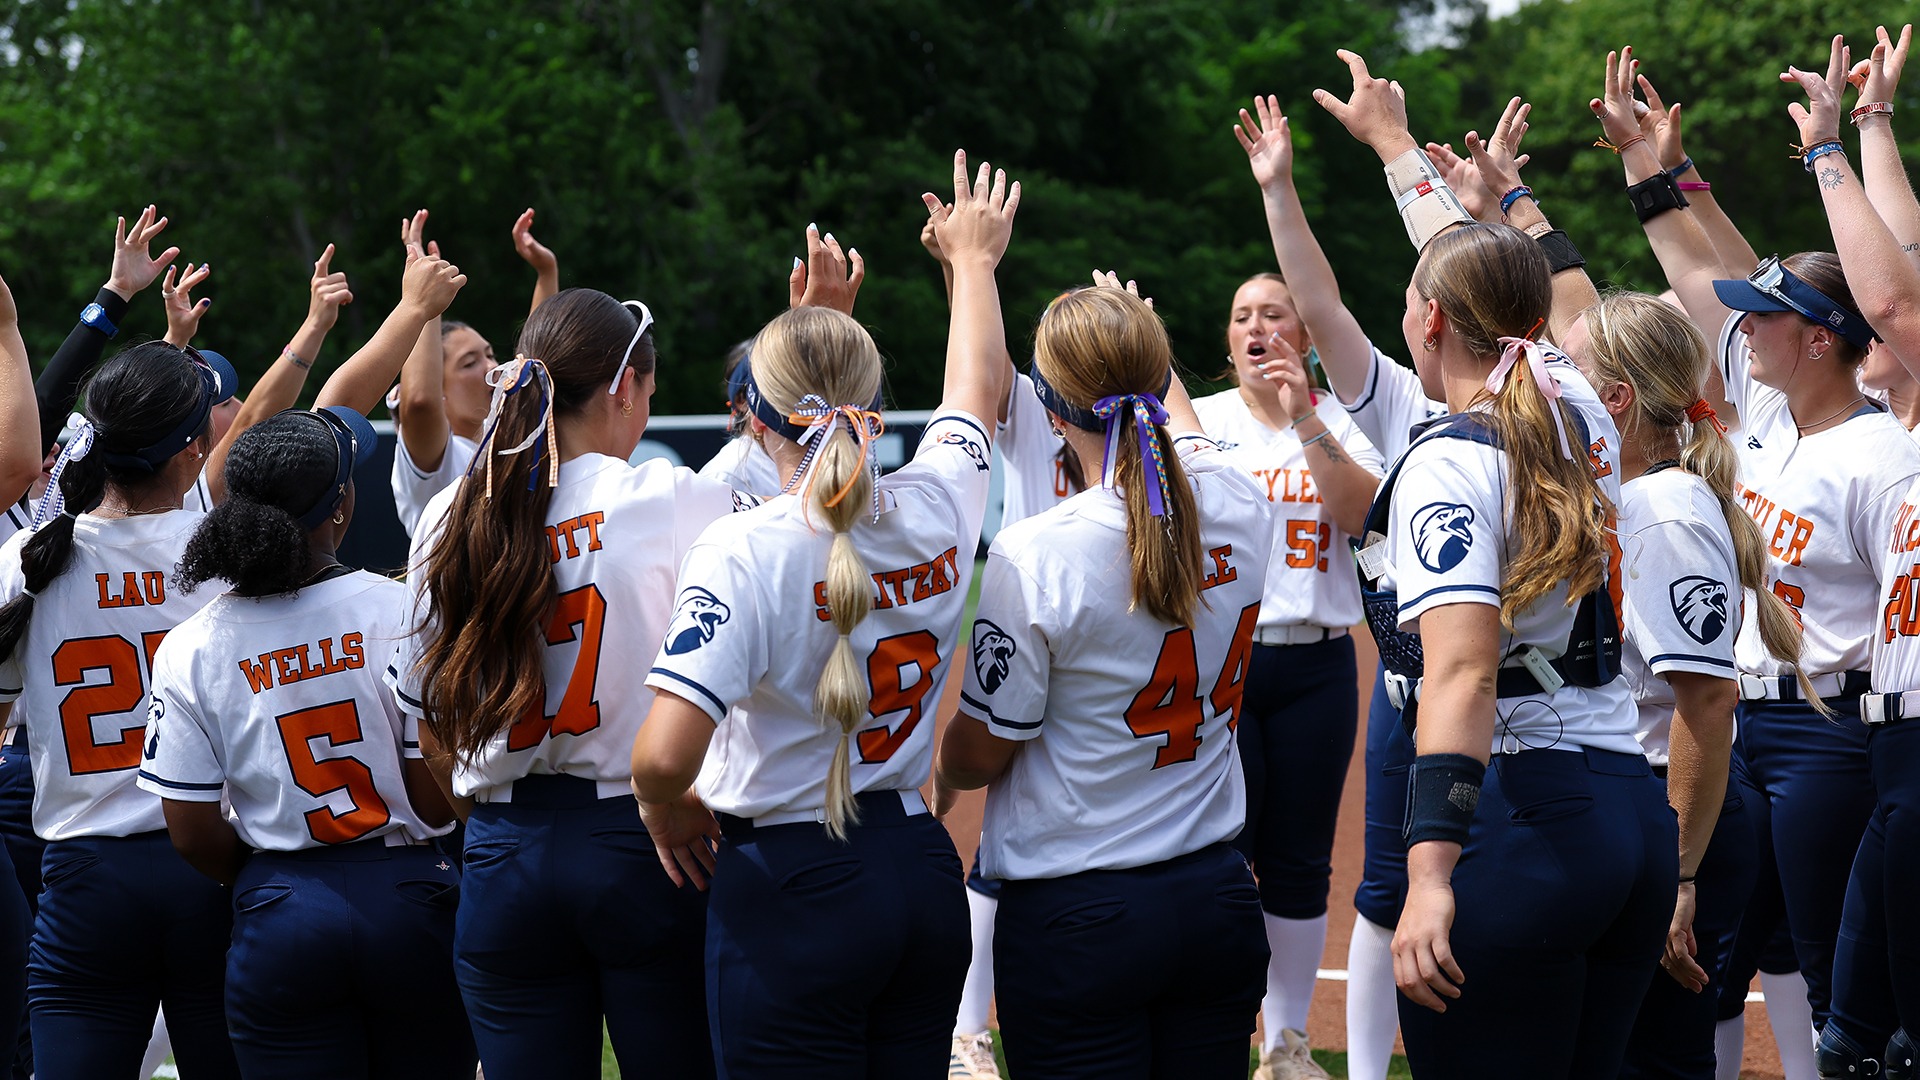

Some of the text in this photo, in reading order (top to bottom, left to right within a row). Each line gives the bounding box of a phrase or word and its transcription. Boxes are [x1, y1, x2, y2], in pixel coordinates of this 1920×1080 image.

[1251, 468, 1324, 504] YLE
[1286, 519, 1331, 573] 52
[95, 571, 165, 609] LAU
[239, 631, 365, 694] WELLS
[1122, 599, 1262, 771] 44
[856, 629, 942, 765] 9
[275, 698, 391, 845] 5
